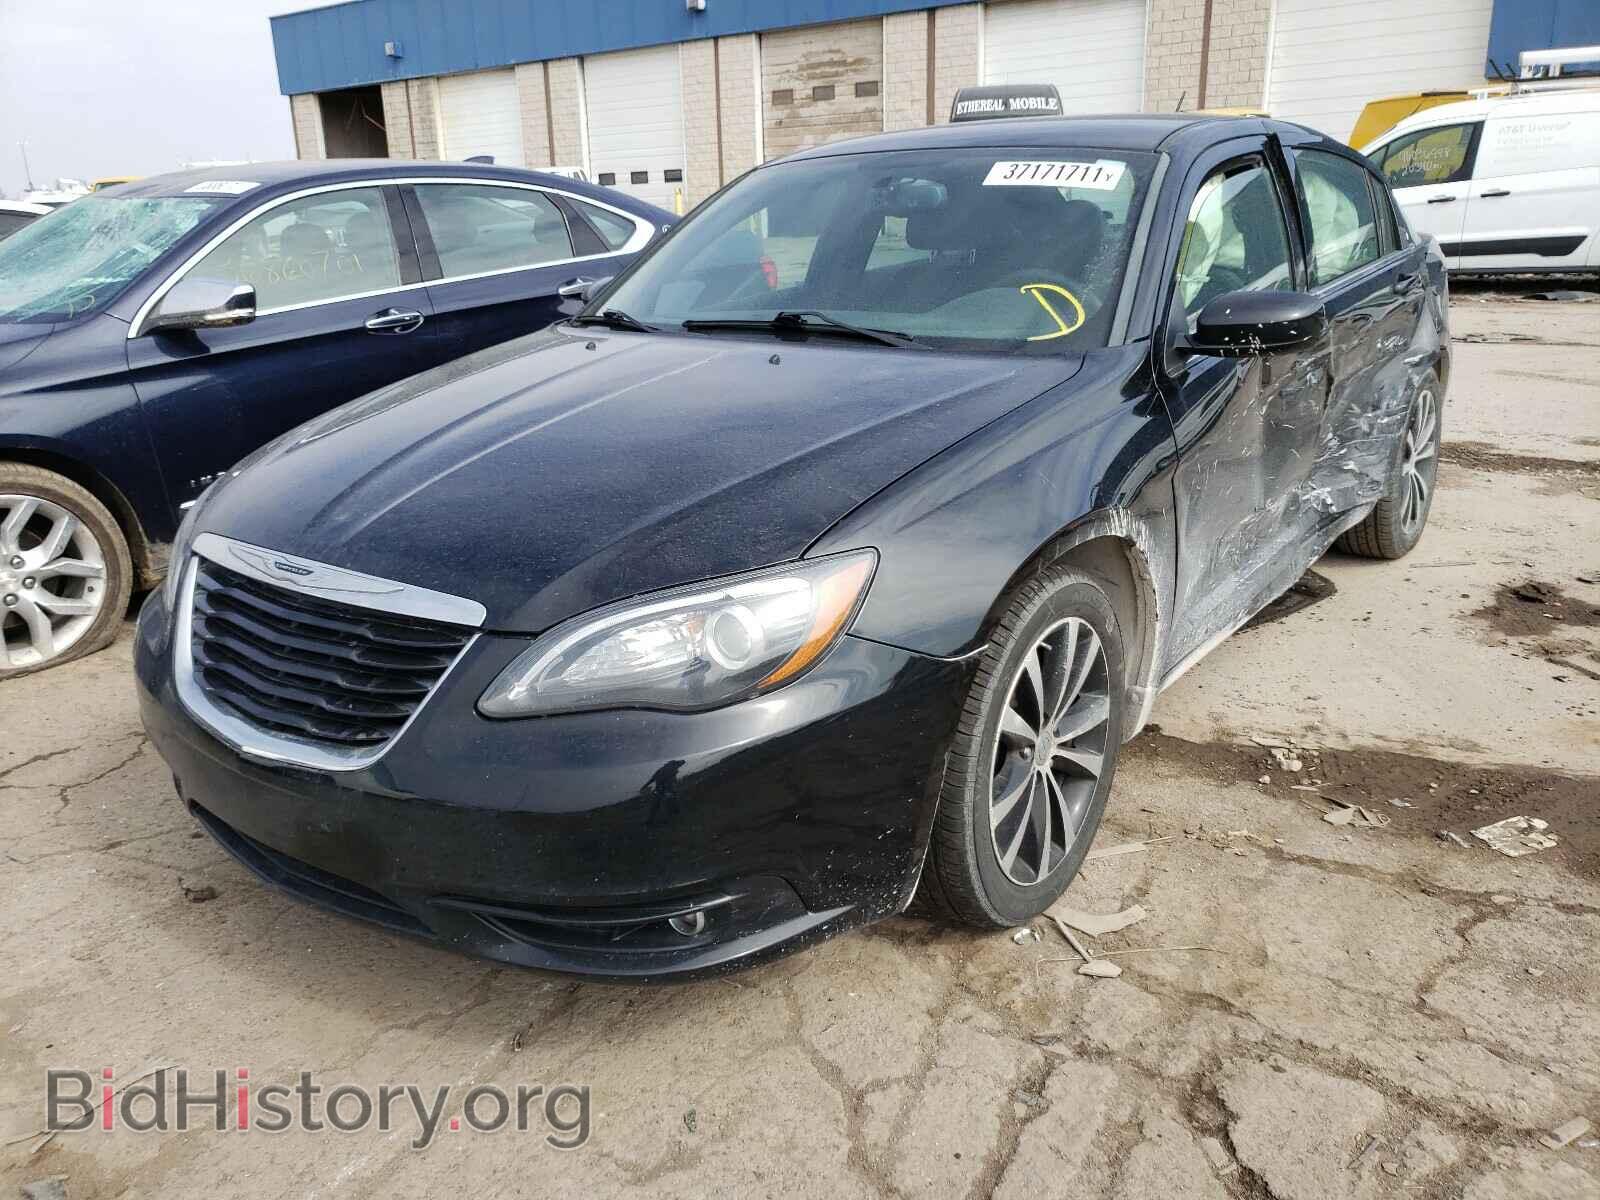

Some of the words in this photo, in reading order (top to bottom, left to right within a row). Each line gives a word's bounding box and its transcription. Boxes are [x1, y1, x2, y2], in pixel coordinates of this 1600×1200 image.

[956, 98, 1005, 115] ETHEREAL
[1008, 97, 1059, 111] MOBILE
[1003, 163, 1103, 183] 37171711
[1020, 283, 1086, 342] D
